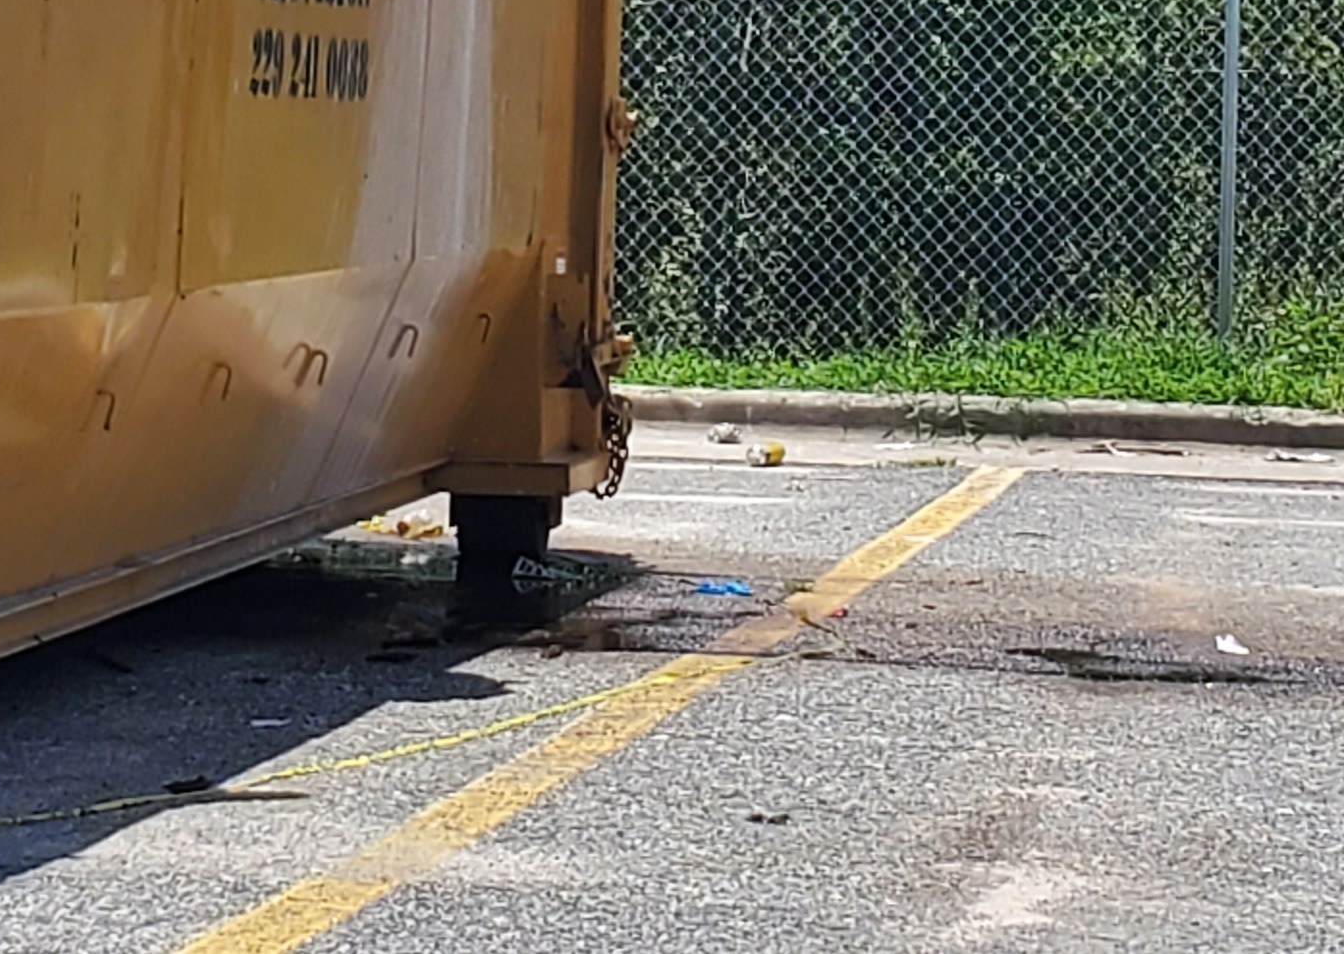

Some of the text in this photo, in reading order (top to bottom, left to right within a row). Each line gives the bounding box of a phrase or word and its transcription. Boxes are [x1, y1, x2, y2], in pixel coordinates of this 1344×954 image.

[249, 28, 369, 102] 229 241 0088
